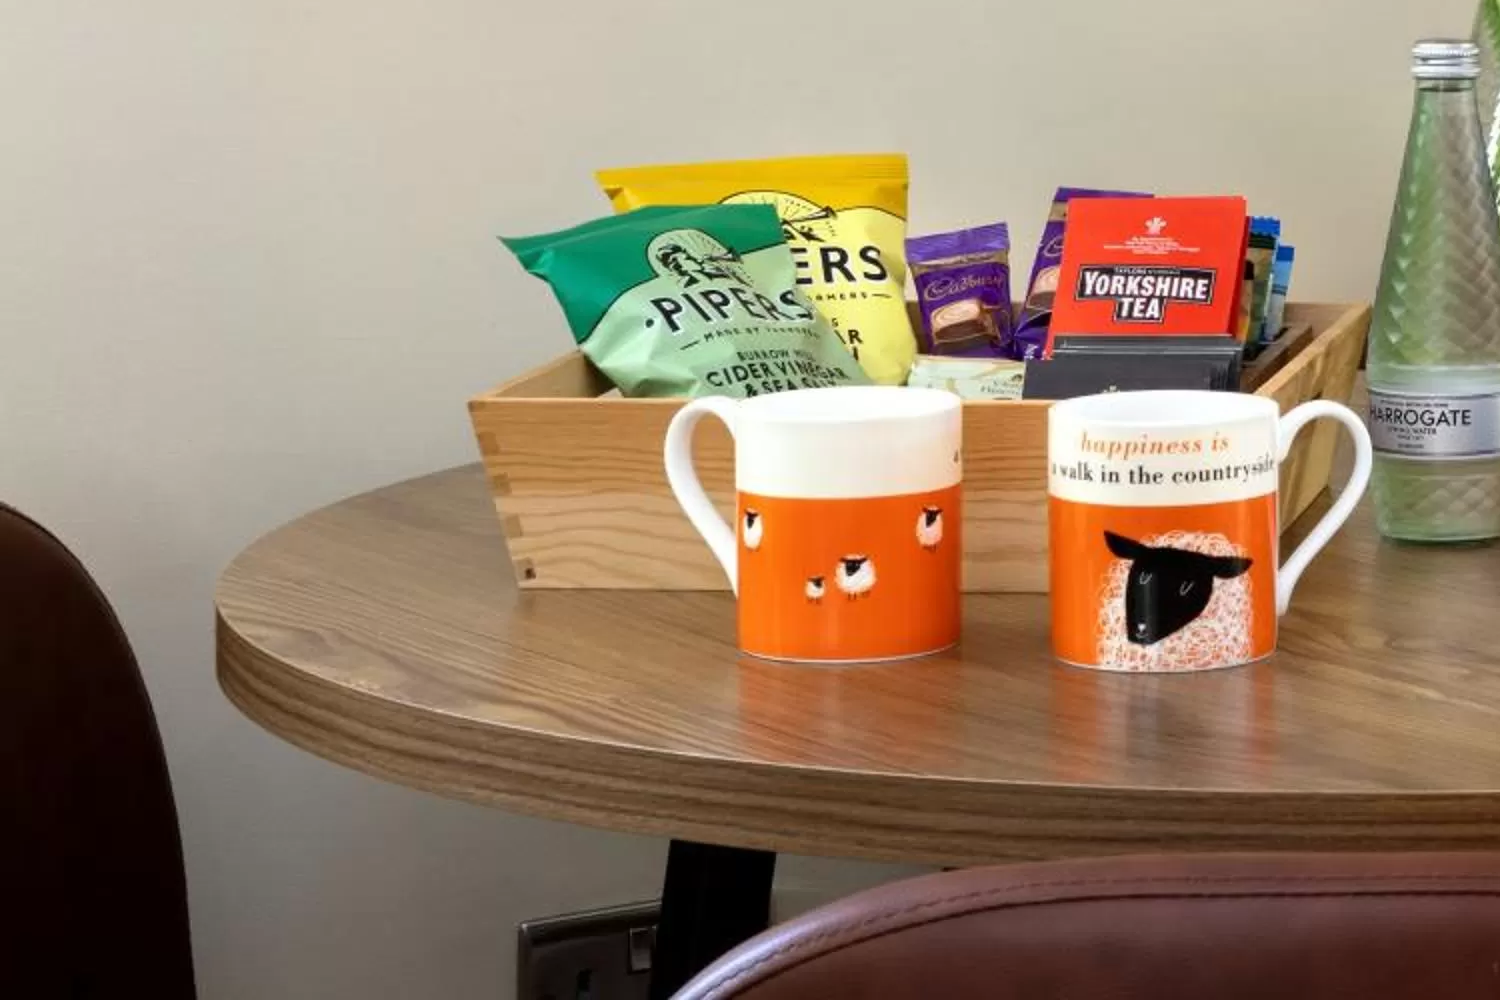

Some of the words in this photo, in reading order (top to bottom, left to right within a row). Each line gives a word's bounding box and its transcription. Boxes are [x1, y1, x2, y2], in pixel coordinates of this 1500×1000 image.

[789, 245, 888, 285] ERS
[923, 273, 1007, 301] Cadbury
[1083, 271, 1209, 300] YORKSHIRE
[650, 286, 814, 333] PIPERS
[1119, 297, 1161, 319] TEA
[705, 361, 775, 388] CIDER
[774, 359, 852, 382] VINEGAR
[761, 378, 799, 394] SEA
[1369, 403, 1472, 426] HARROGATE
[1080, 430, 1202, 460] happiness
[1210, 431, 1230, 452] is
[1060, 460, 1094, 482] walk
[1101, 464, 1120, 484] in
[1129, 464, 1165, 485] the
[1171, 451, 1275, 485] countryside
